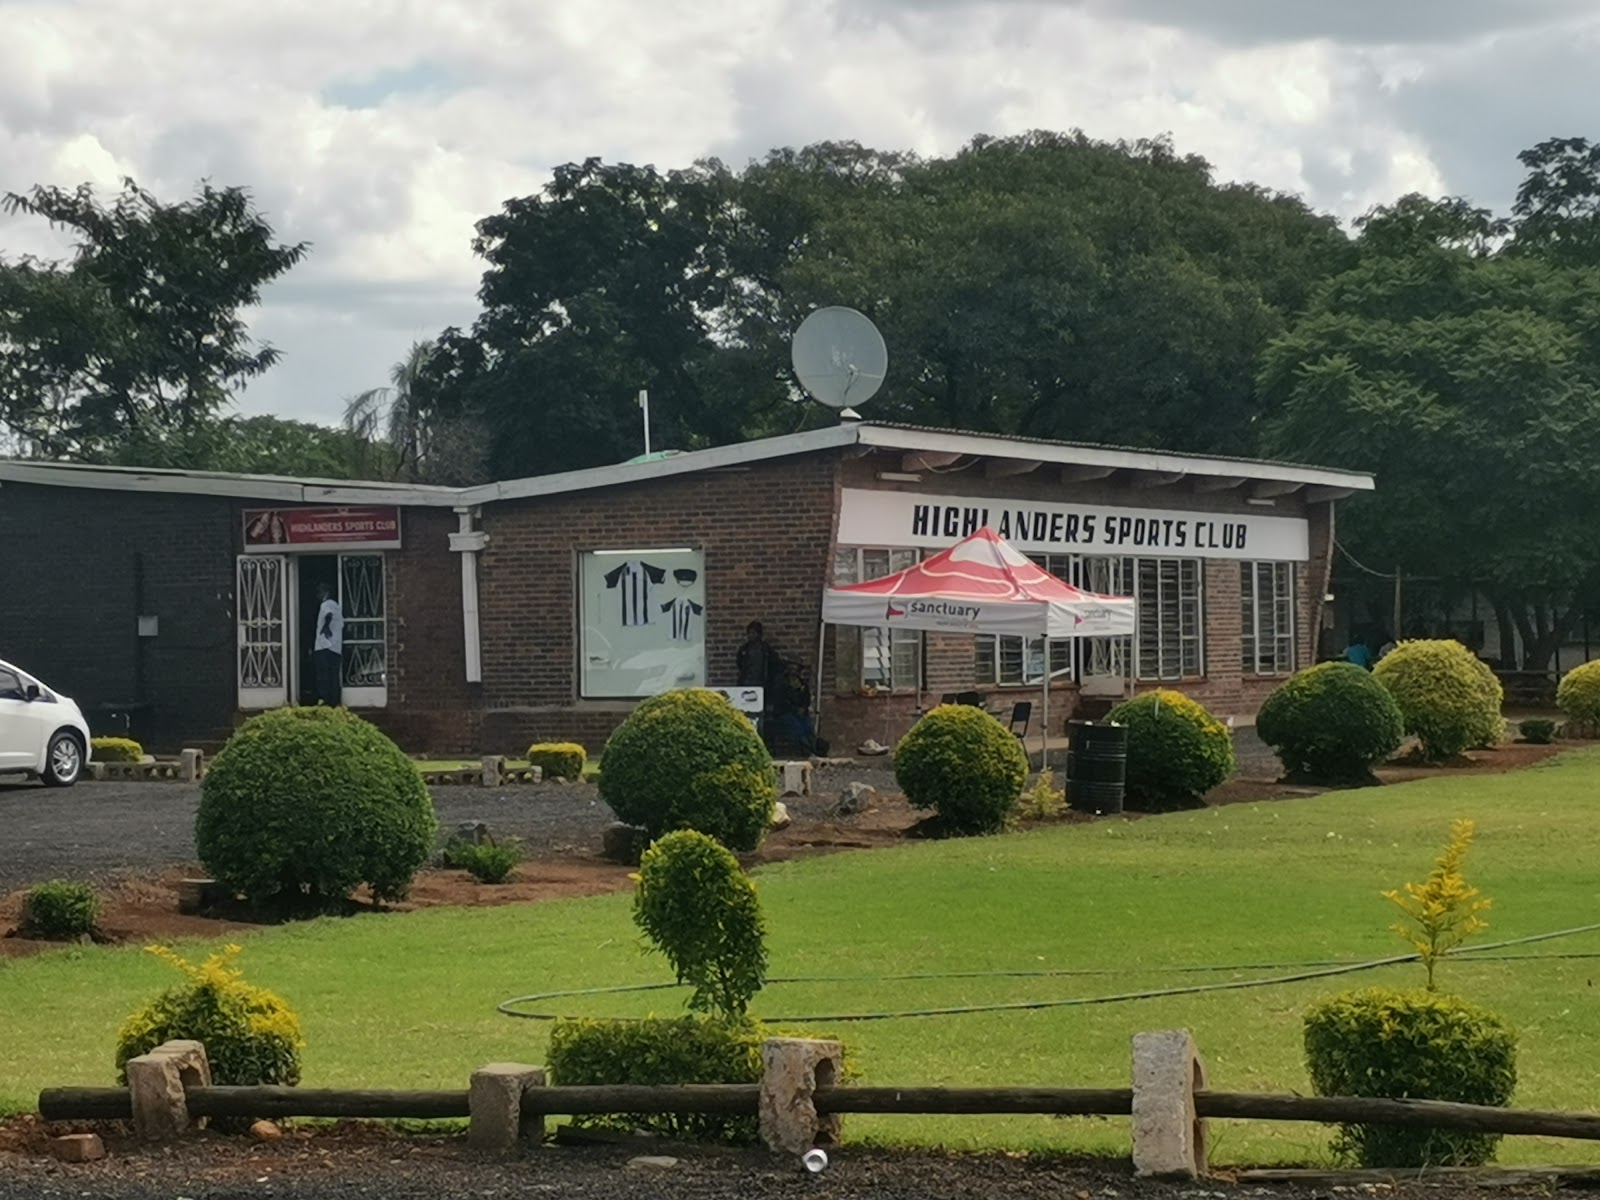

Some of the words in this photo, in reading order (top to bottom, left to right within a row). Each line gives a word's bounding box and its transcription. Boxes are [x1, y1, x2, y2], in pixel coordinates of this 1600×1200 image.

[291, 521, 343, 533] HIGHLANDERS
[345, 520, 374, 532] SPORTS
[376, 520, 396, 531] CLUB
[1103, 516, 1187, 548] SPORTS
[1194, 521, 1247, 549] CLUB
[911, 602, 981, 621] sanctuary
